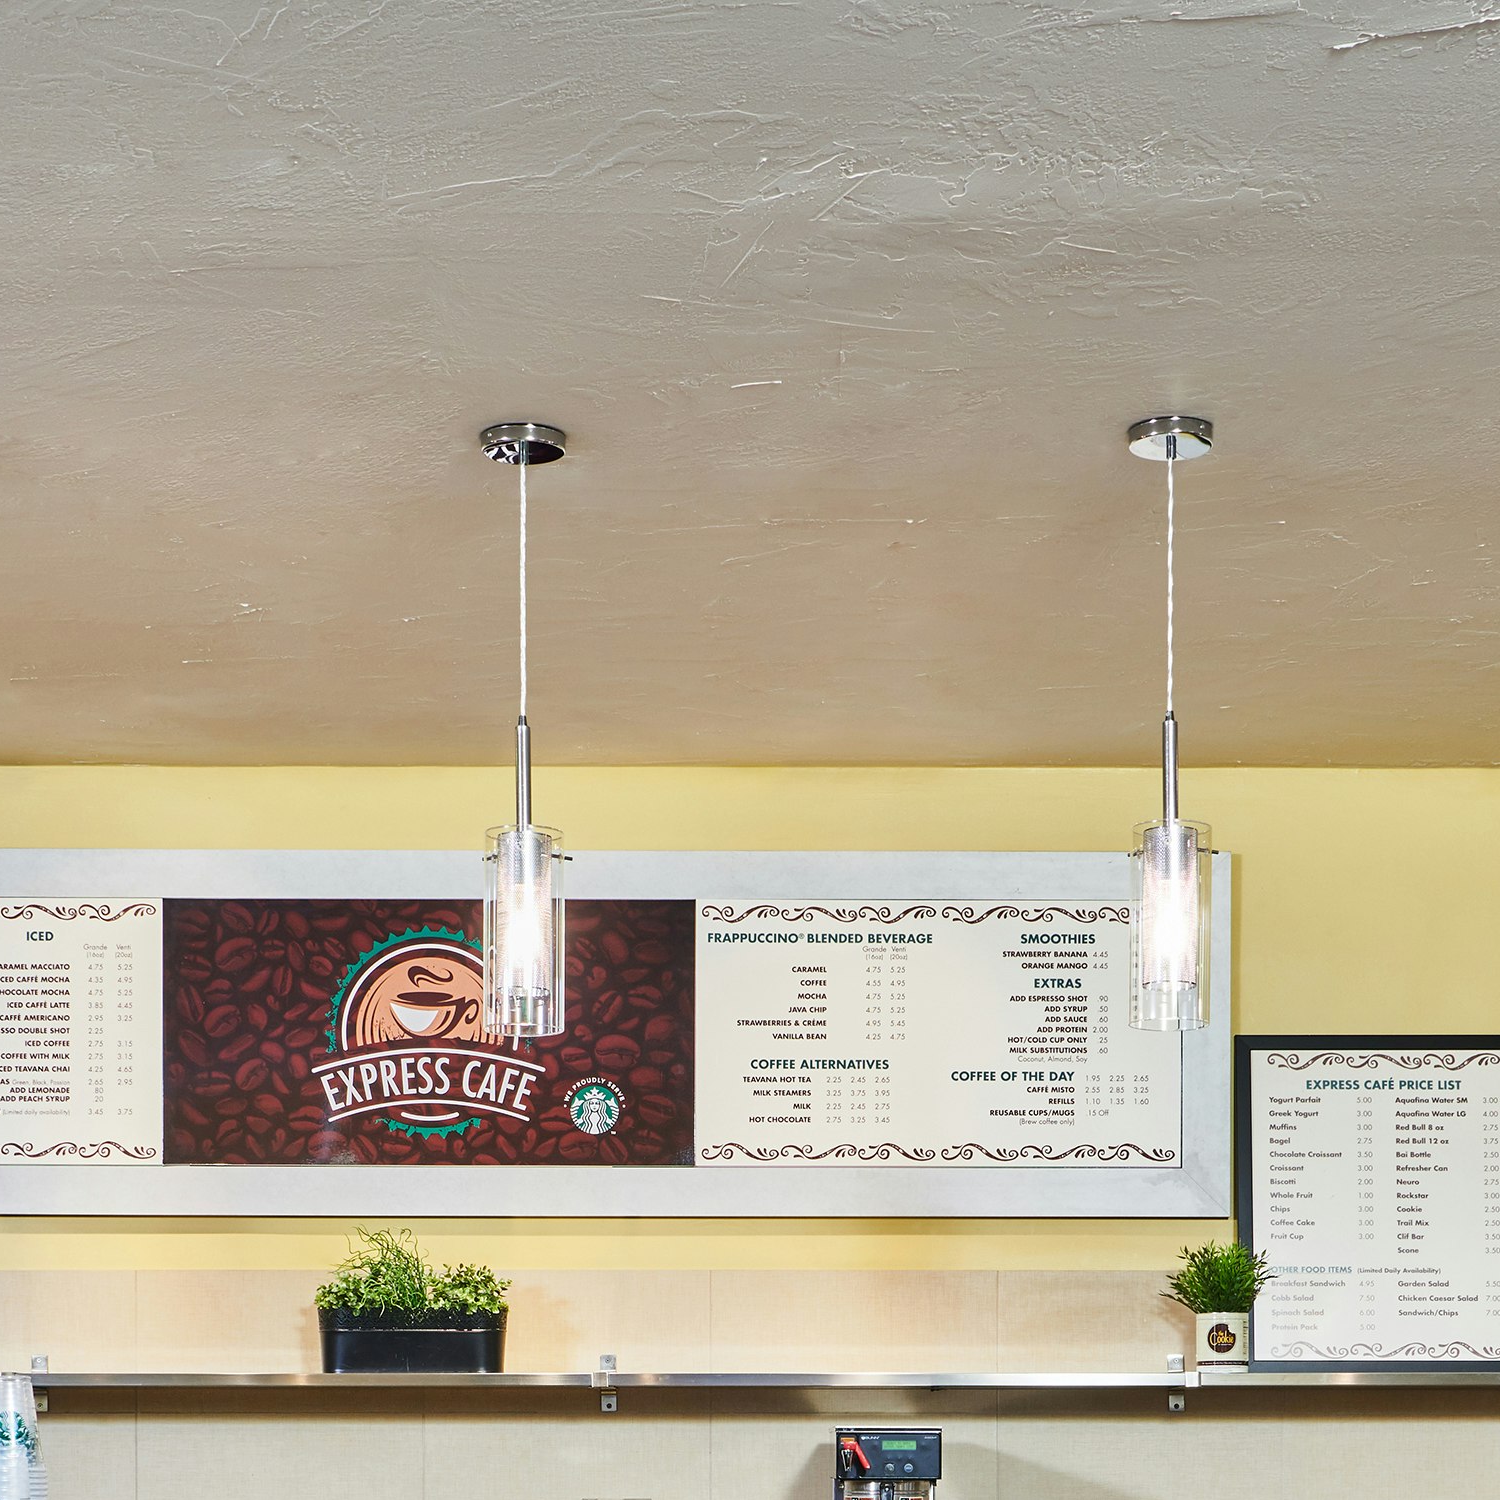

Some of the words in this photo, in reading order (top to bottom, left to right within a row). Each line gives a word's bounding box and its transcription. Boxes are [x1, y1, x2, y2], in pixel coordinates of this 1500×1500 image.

[26, 930, 54, 942] ICED
[807, 933, 864, 944] BLENDED
[867, 933, 933, 945] BEVERAGE
[1020, 933, 1096, 945] SMOOTHIES
[1002, 950, 1052, 958] STRAWBERRY
[1053, 950, 1089, 958] BANANA
[30, 963, 71, 971] MACCIATO
[1034, 978, 1082, 989] EXTRAS
[788, 1006, 808, 1014] JAVA
[808, 1006, 828, 1014] CHIP
[17, 1027, 48, 1035] DOUBLE
[49, 1027, 71, 1035] SHOT
[1036, 1026, 1054, 1034] ADD
[1055, 1026, 1088, 1034] PROTEIN
[0, 1052, 28, 1060] COFFEE
[29, 1052, 50, 1060] WITH
[750, 1058, 796, 1070] COFFEE
[799, 1059, 890, 1070] ALTERNATIVES
[950, 1070, 997, 1082] COFFEE
[1000, 1070, 1018, 1082] OF
[1021, 1071, 1045, 1082] THE
[1049, 1071, 1075, 1082] DAY
[320, 1057, 451, 1113] EXPRESS
[462, 1060, 537, 1113] CAFE
[1305, 1079, 1360, 1091] EXPRESS
[1363, 1076, 1395, 1091] CAFÉ
[1398, 1079, 1434, 1091] PRICE
[1437, 1079, 1462, 1091] LIST
[563, 1090, 574, 1102] WE
[572, 1077, 607, 1091] PROUDLY
[606, 1081, 626, 1102] SERVE
[752, 1089, 772, 1097] MILK
[773, 1089, 812, 1097] STEAMERS
[1048, 1097, 1076, 1105] REFILLS
[1394, 1096, 1430, 1105] Aquafina
[1431, 1096, 1455, 1104] Water
[1456, 1096, 1469, 1104] SM
[989, 1109, 1027, 1117] REUSABLE
[1028, 1109, 1075, 1118] CUPS/MUGS
[748, 1116, 766, 1124] HOT
[766, 1116, 811, 1124] CHOCOLATE
[1395, 1137, 1411, 1145] Red
[1411, 1137, 1427, 1145] Bull
[1428, 1137, 1439, 1145] 12
[1269, 1150, 1306, 1158] Chocolate
[1307, 1150, 1343, 1158] Croissant
[1395, 1164, 1432, 1172] Refresher
[1433, 1164, 1449, 1172] Can
[1396, 1191, 1429, 1199] Rockstar
[1398, 1309, 1459, 1318] Sandwich/Chips
